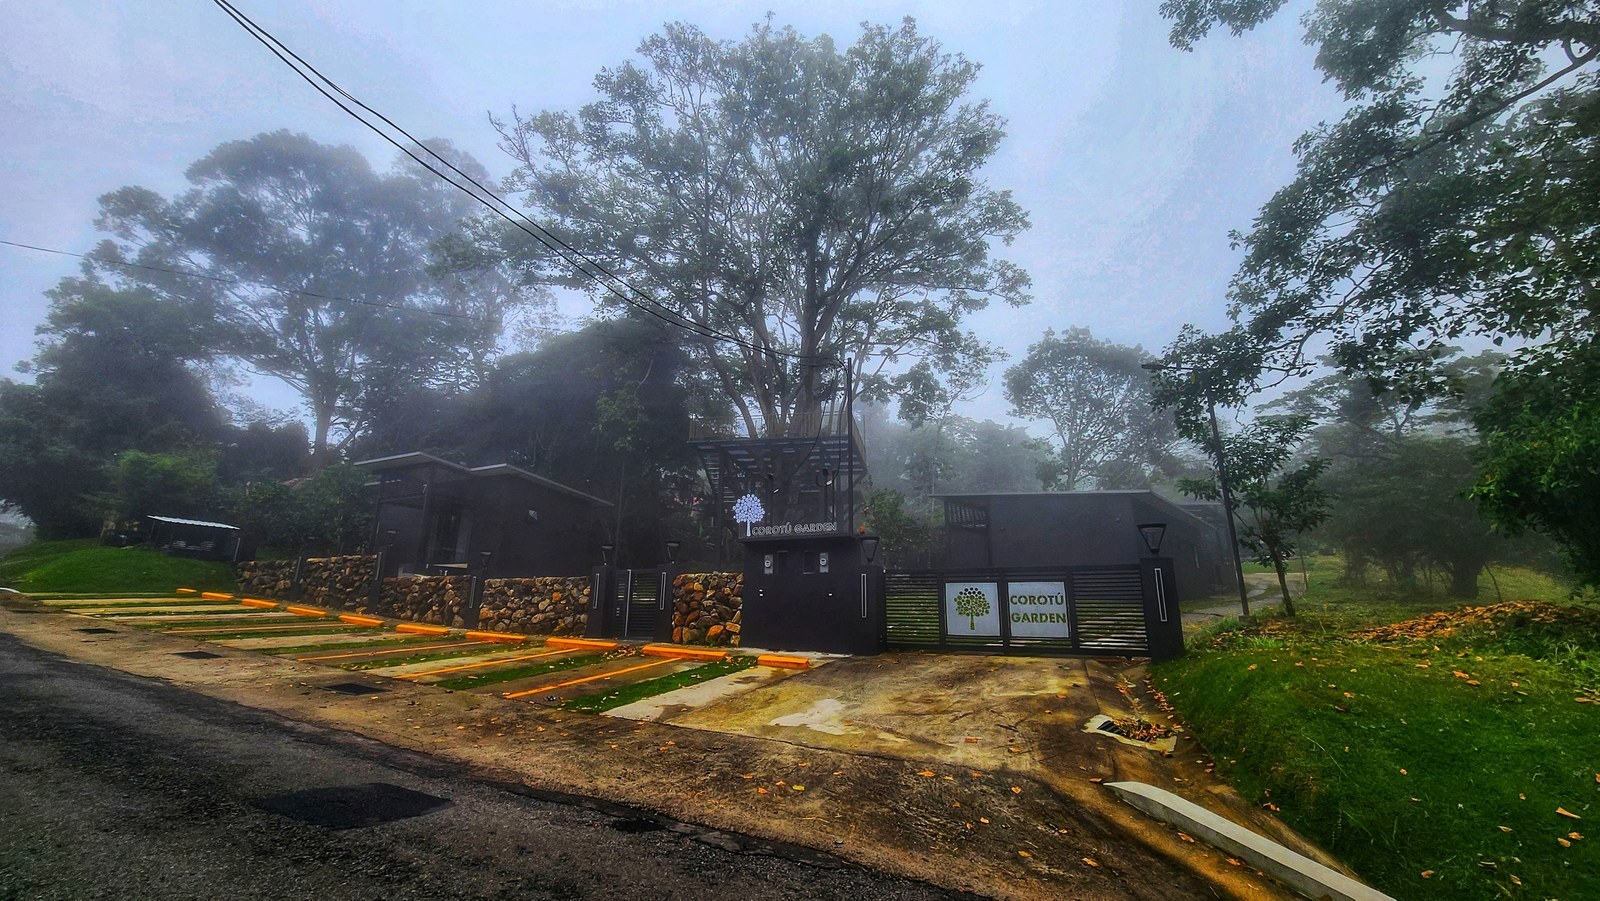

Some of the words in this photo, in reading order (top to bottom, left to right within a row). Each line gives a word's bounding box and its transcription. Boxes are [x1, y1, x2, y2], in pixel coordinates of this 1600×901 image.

[752, 522, 791, 535] COROTÚ
[794, 522, 837, 533] GARDEN
[1010, 592, 1064, 605] COROTÚ
[1011, 612, 1066, 623] GARDEN
